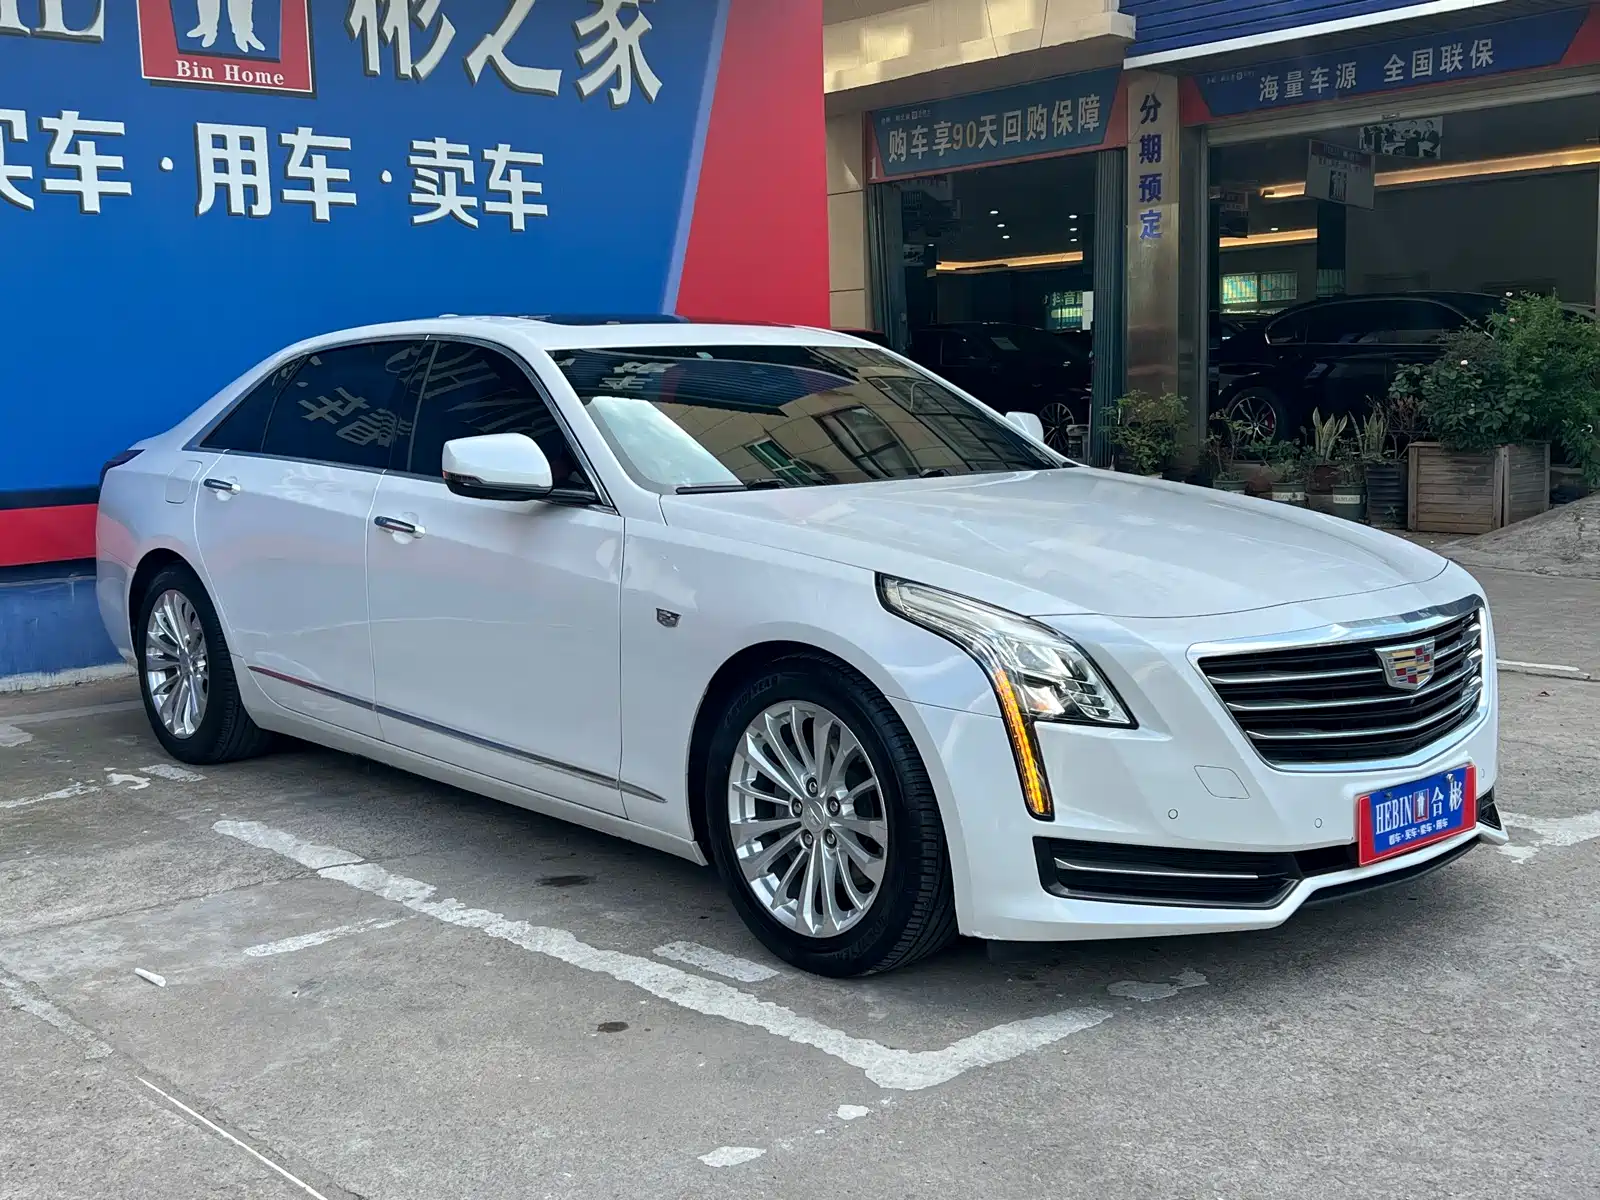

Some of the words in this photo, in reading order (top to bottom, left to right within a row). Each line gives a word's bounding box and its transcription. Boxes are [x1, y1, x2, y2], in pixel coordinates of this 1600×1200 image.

[176, 60, 214, 79] Bin
[223, 64, 284, 85] Home
[1258, 61, 1357, 102] 海量车源
[1383, 38, 1494, 84] 全国联保
[888, 94, 1101, 163] 购车享90天回购保障
[1138, 93, 1163, 240] 分期预定
[1375, 794, 1412, 835] HEBIN
